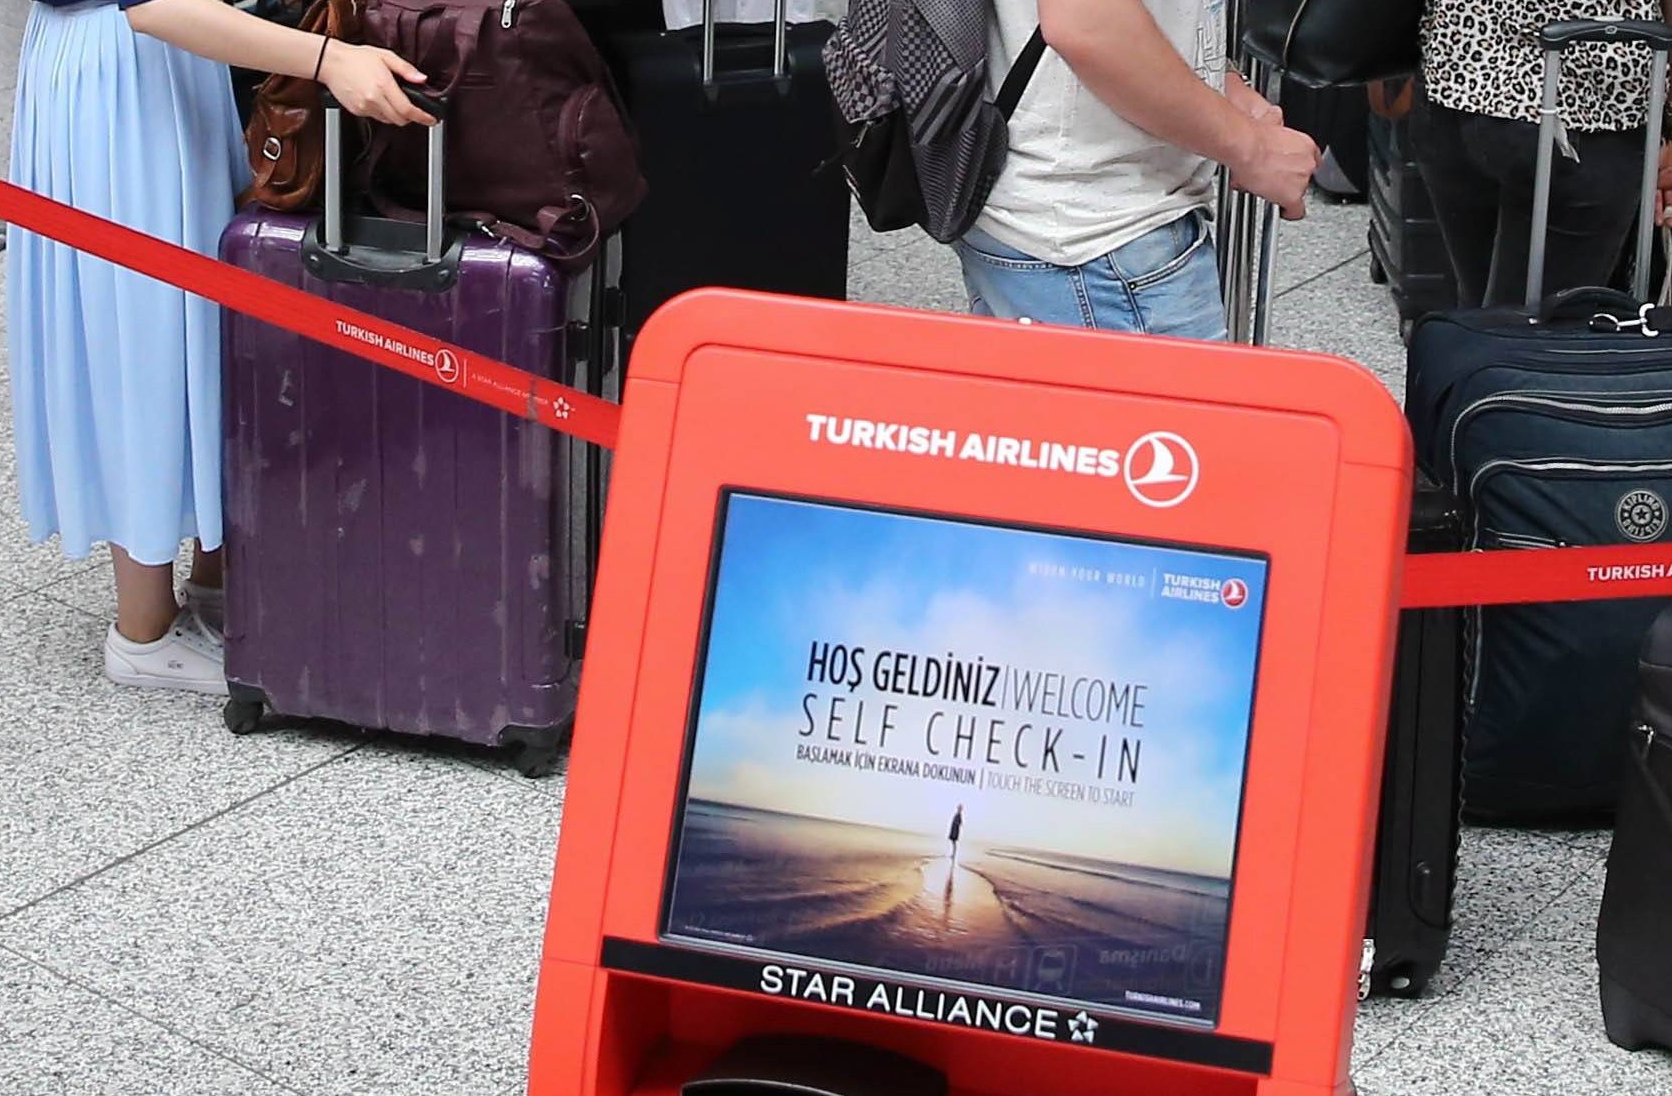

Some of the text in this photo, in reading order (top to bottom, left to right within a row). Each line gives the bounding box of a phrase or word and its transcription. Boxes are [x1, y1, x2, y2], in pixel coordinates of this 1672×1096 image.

[335, 320, 435, 367] TURKISH AIRLINES
[805, 412, 1120, 478] TURKISH AIRLINES
[1622, 493, 1660, 511] KIPLING
[1622, 518, 1661, 537] KIPLING
[1161, 584, 1220, 604] AIRLINES
[1163, 572, 1222, 591] TURKISH
[1587, 563, 1669, 582] TURKISH
[806, 640, 1149, 728] HOŞ GELDİNİZ WELCOME
[798, 693, 1142, 785] SELF CHECK-IN
[796, 744, 1135, 808] BAŞLAMAK İÇİN EKRANA DOKUNUN TOUCH THE SCREEN TO START
[760, 964, 1059, 1040] STAR ALLIANCE
